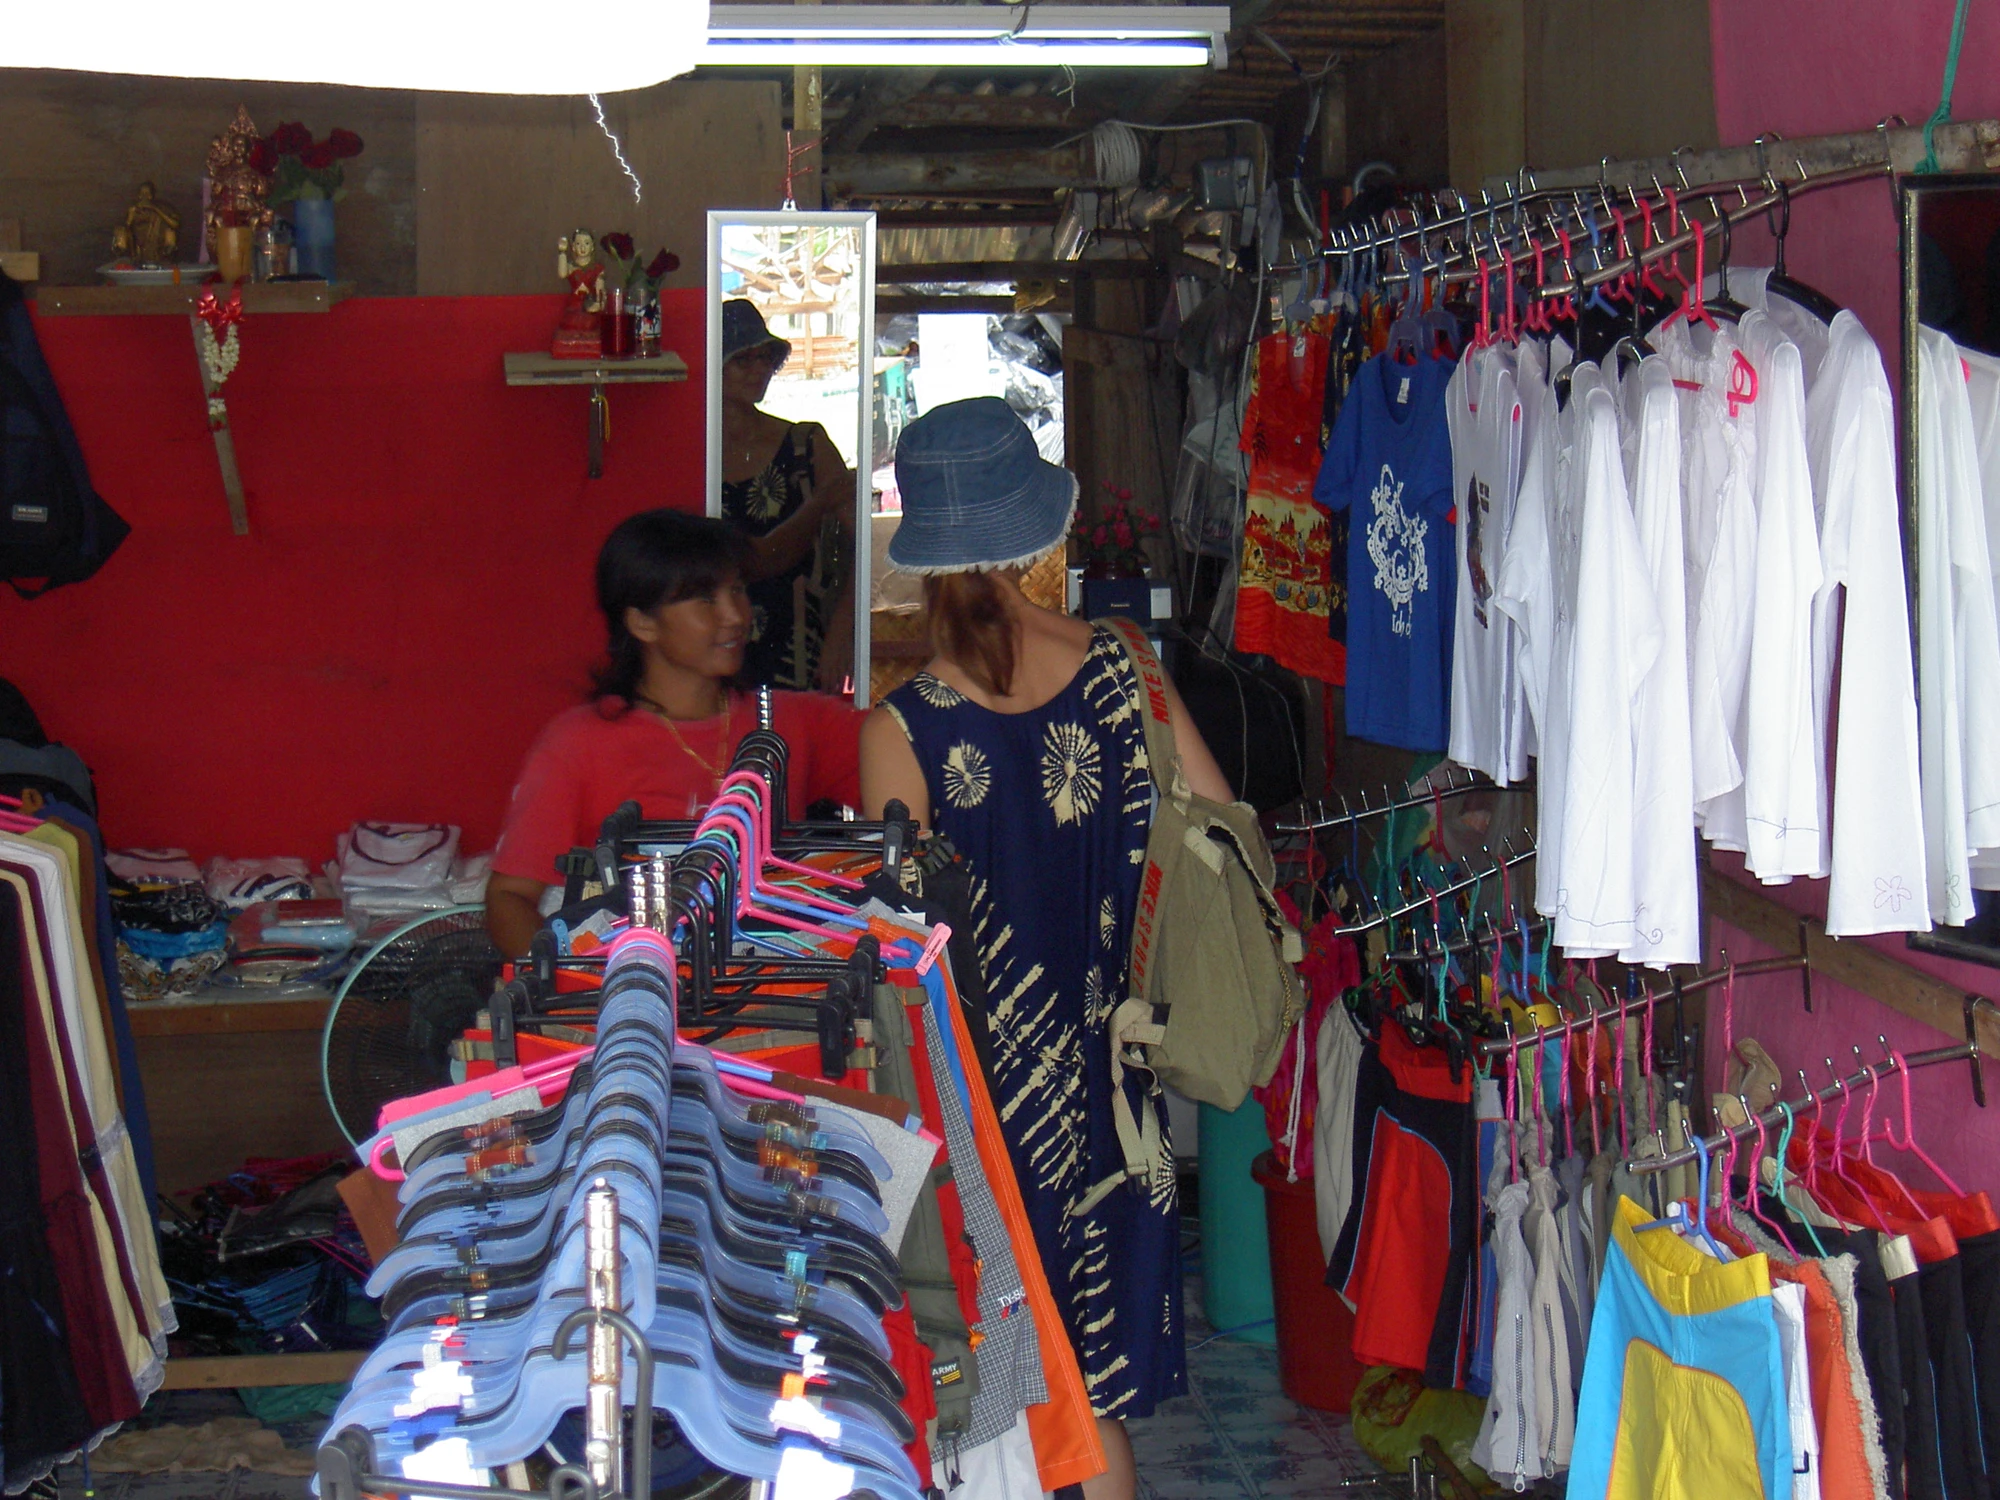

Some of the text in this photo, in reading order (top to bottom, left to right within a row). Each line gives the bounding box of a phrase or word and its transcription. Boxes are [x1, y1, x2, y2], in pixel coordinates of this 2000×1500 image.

[1142, 670, 1170, 726] NIKE
[1132, 859, 1163, 993] NIKE SPORT
[932, 1363, 957, 1376] ARMY
